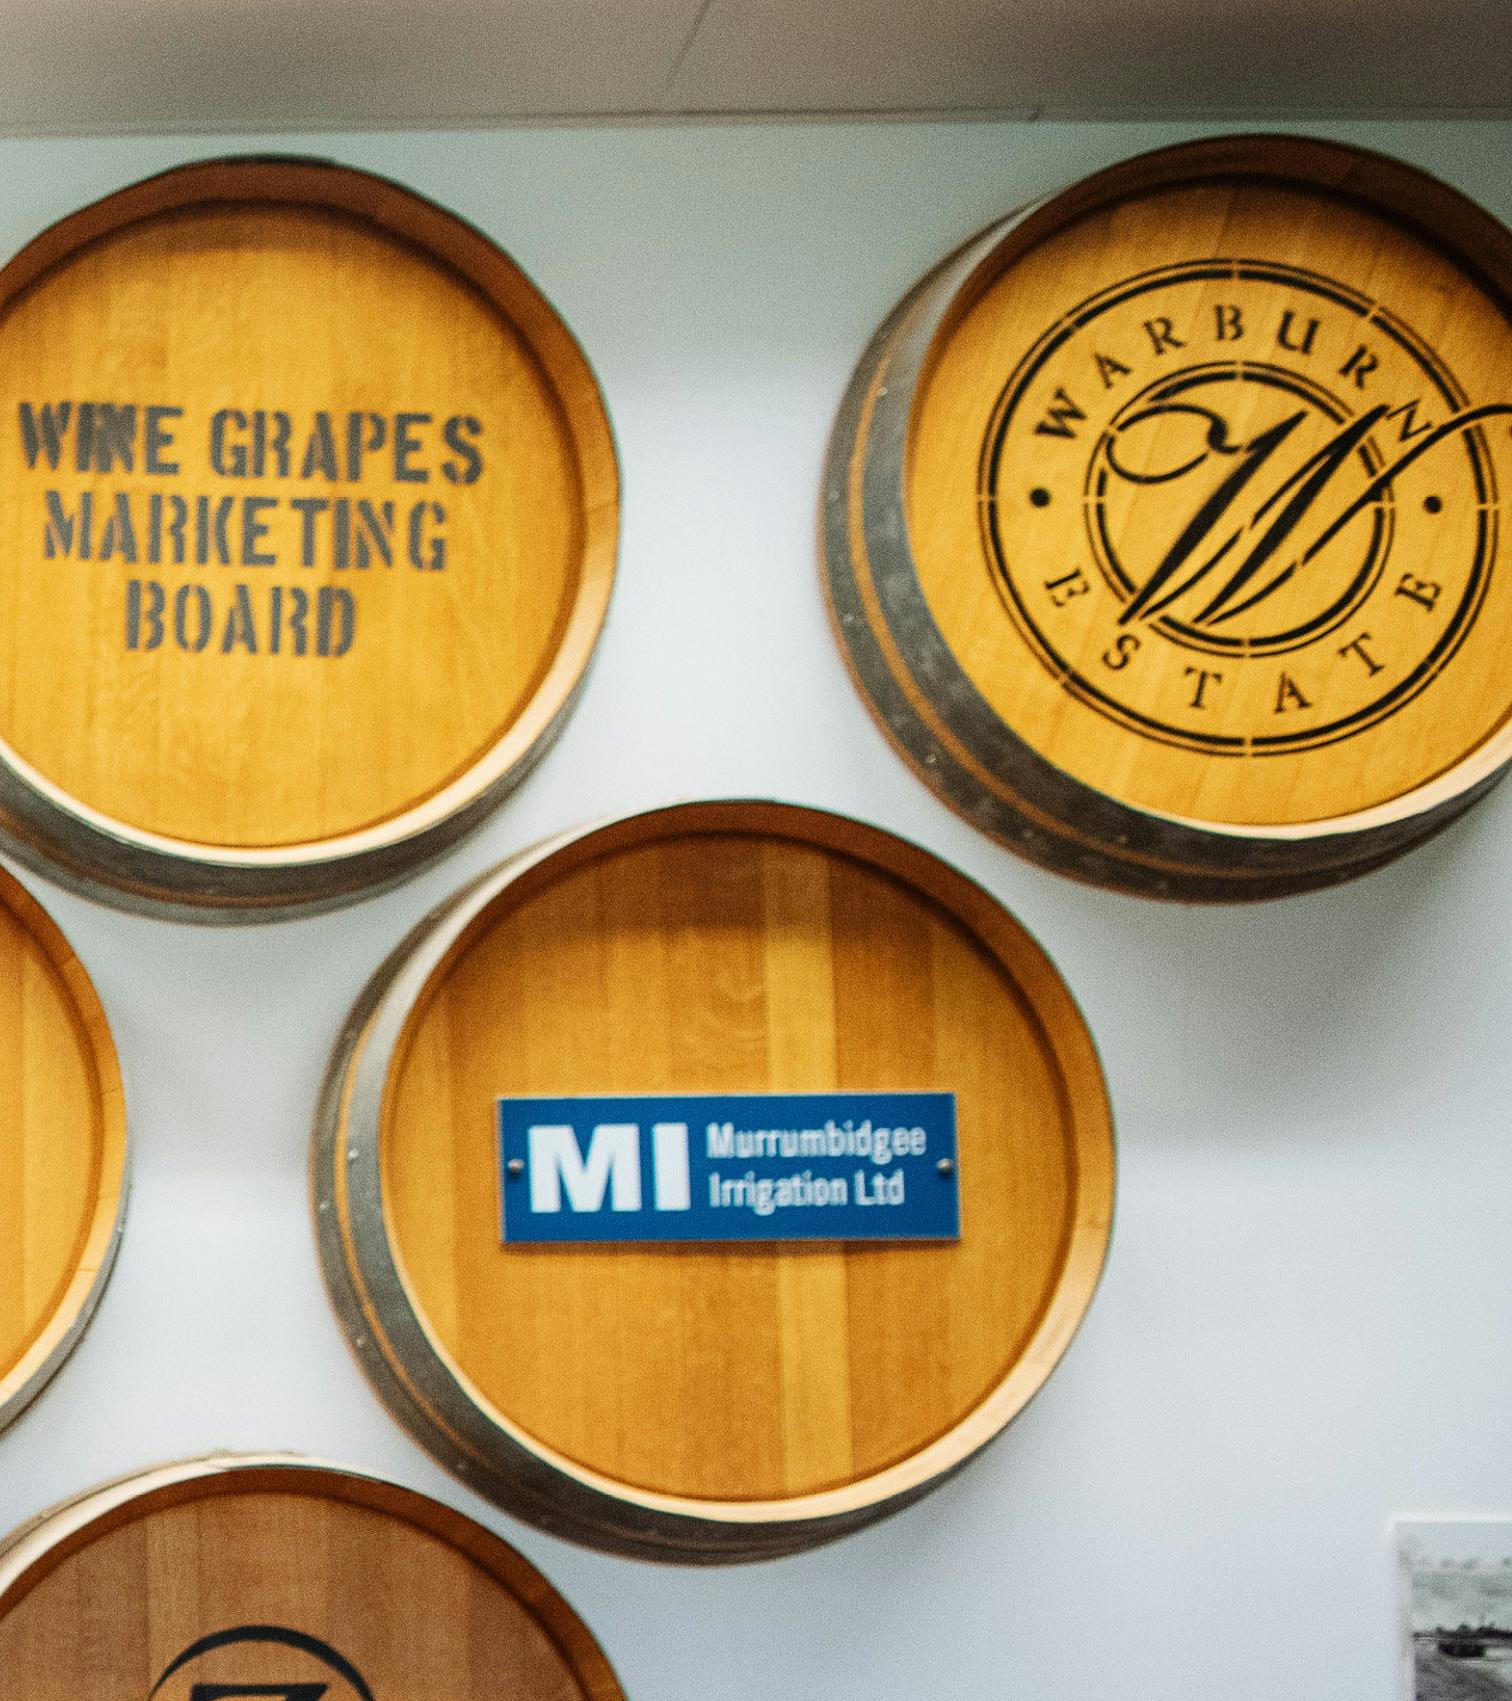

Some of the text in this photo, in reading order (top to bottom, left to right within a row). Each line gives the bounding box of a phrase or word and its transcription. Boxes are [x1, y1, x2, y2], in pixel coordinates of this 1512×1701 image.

[1035, 304, 1433, 442] WARBURN
[19, 401, 485, 486] WINE GRAPES
[43, 490, 448, 571] MARKETING
[124, 579, 357, 658] BOARD
[1044, 567, 1442, 714] ESTATE
[528, 1122, 692, 1213] MI
[707, 1119, 927, 1164] Murrumbidgee
[709, 1170, 904, 1216] Irrigation Ltd
